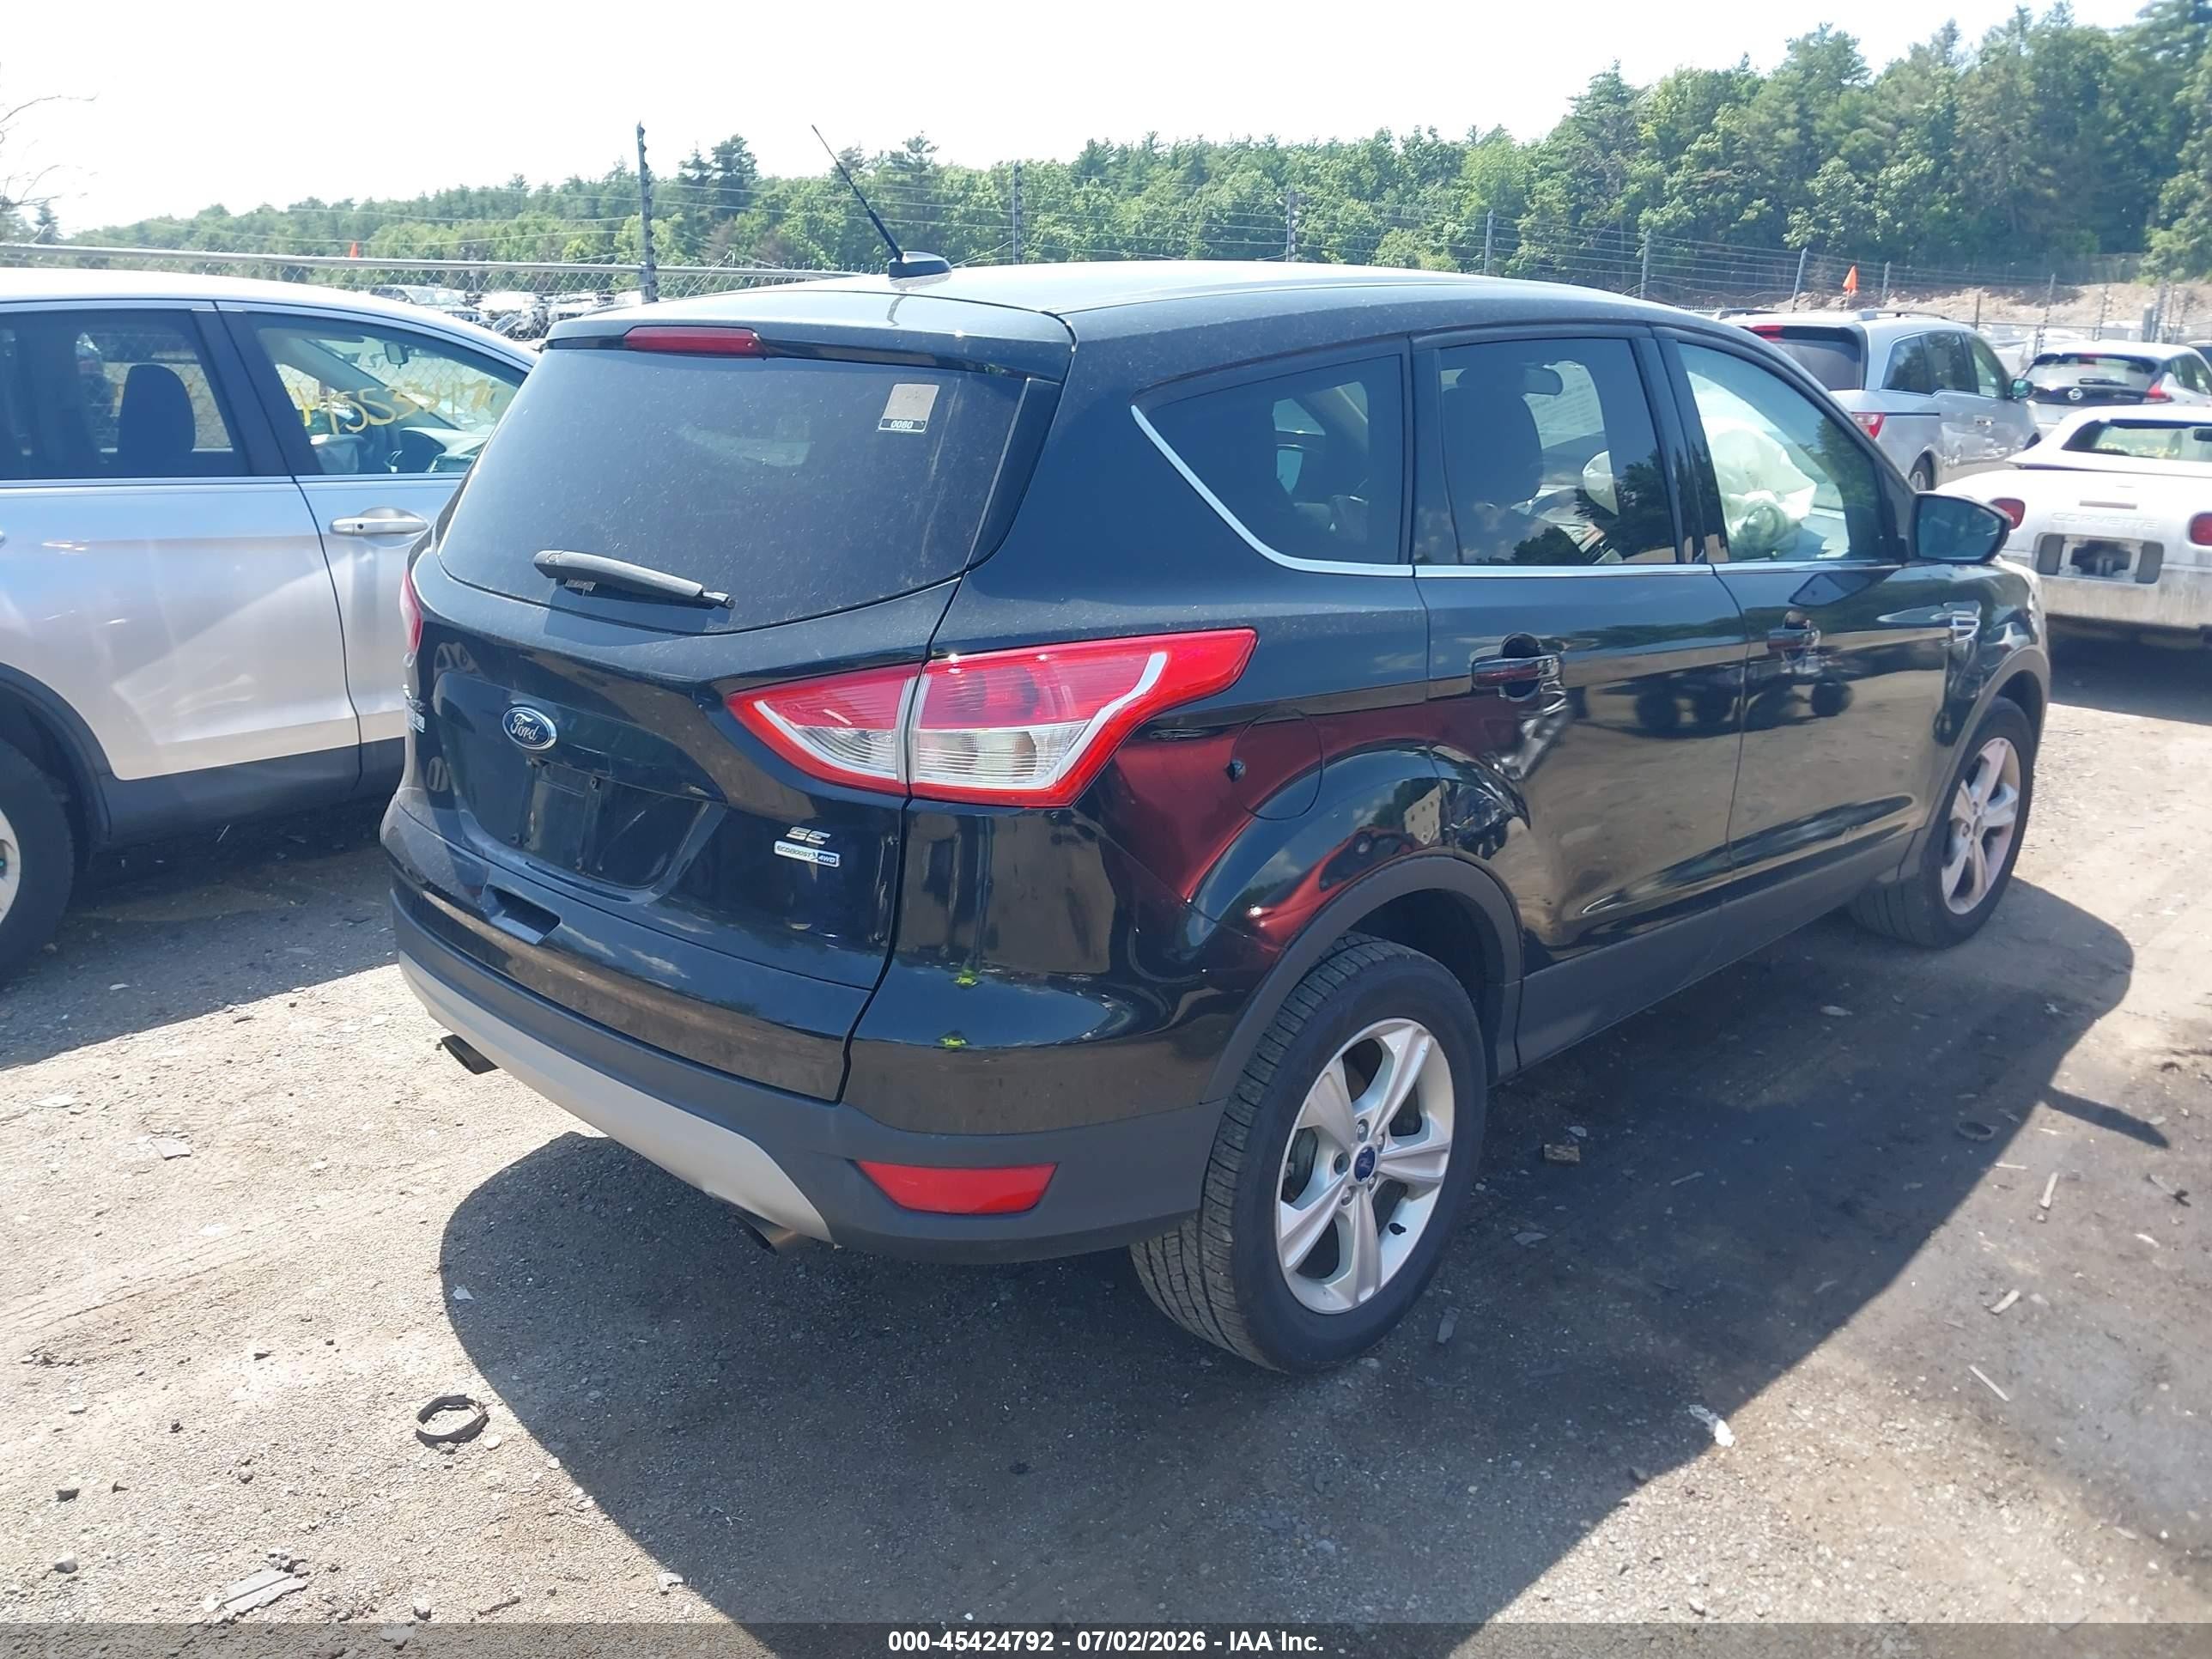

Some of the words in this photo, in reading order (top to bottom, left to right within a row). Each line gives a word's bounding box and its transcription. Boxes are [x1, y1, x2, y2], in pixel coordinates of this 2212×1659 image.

[510, 713, 540, 741] Ford
[785, 826, 832, 845] SE
[817, 854, 836, 863] 4WD
